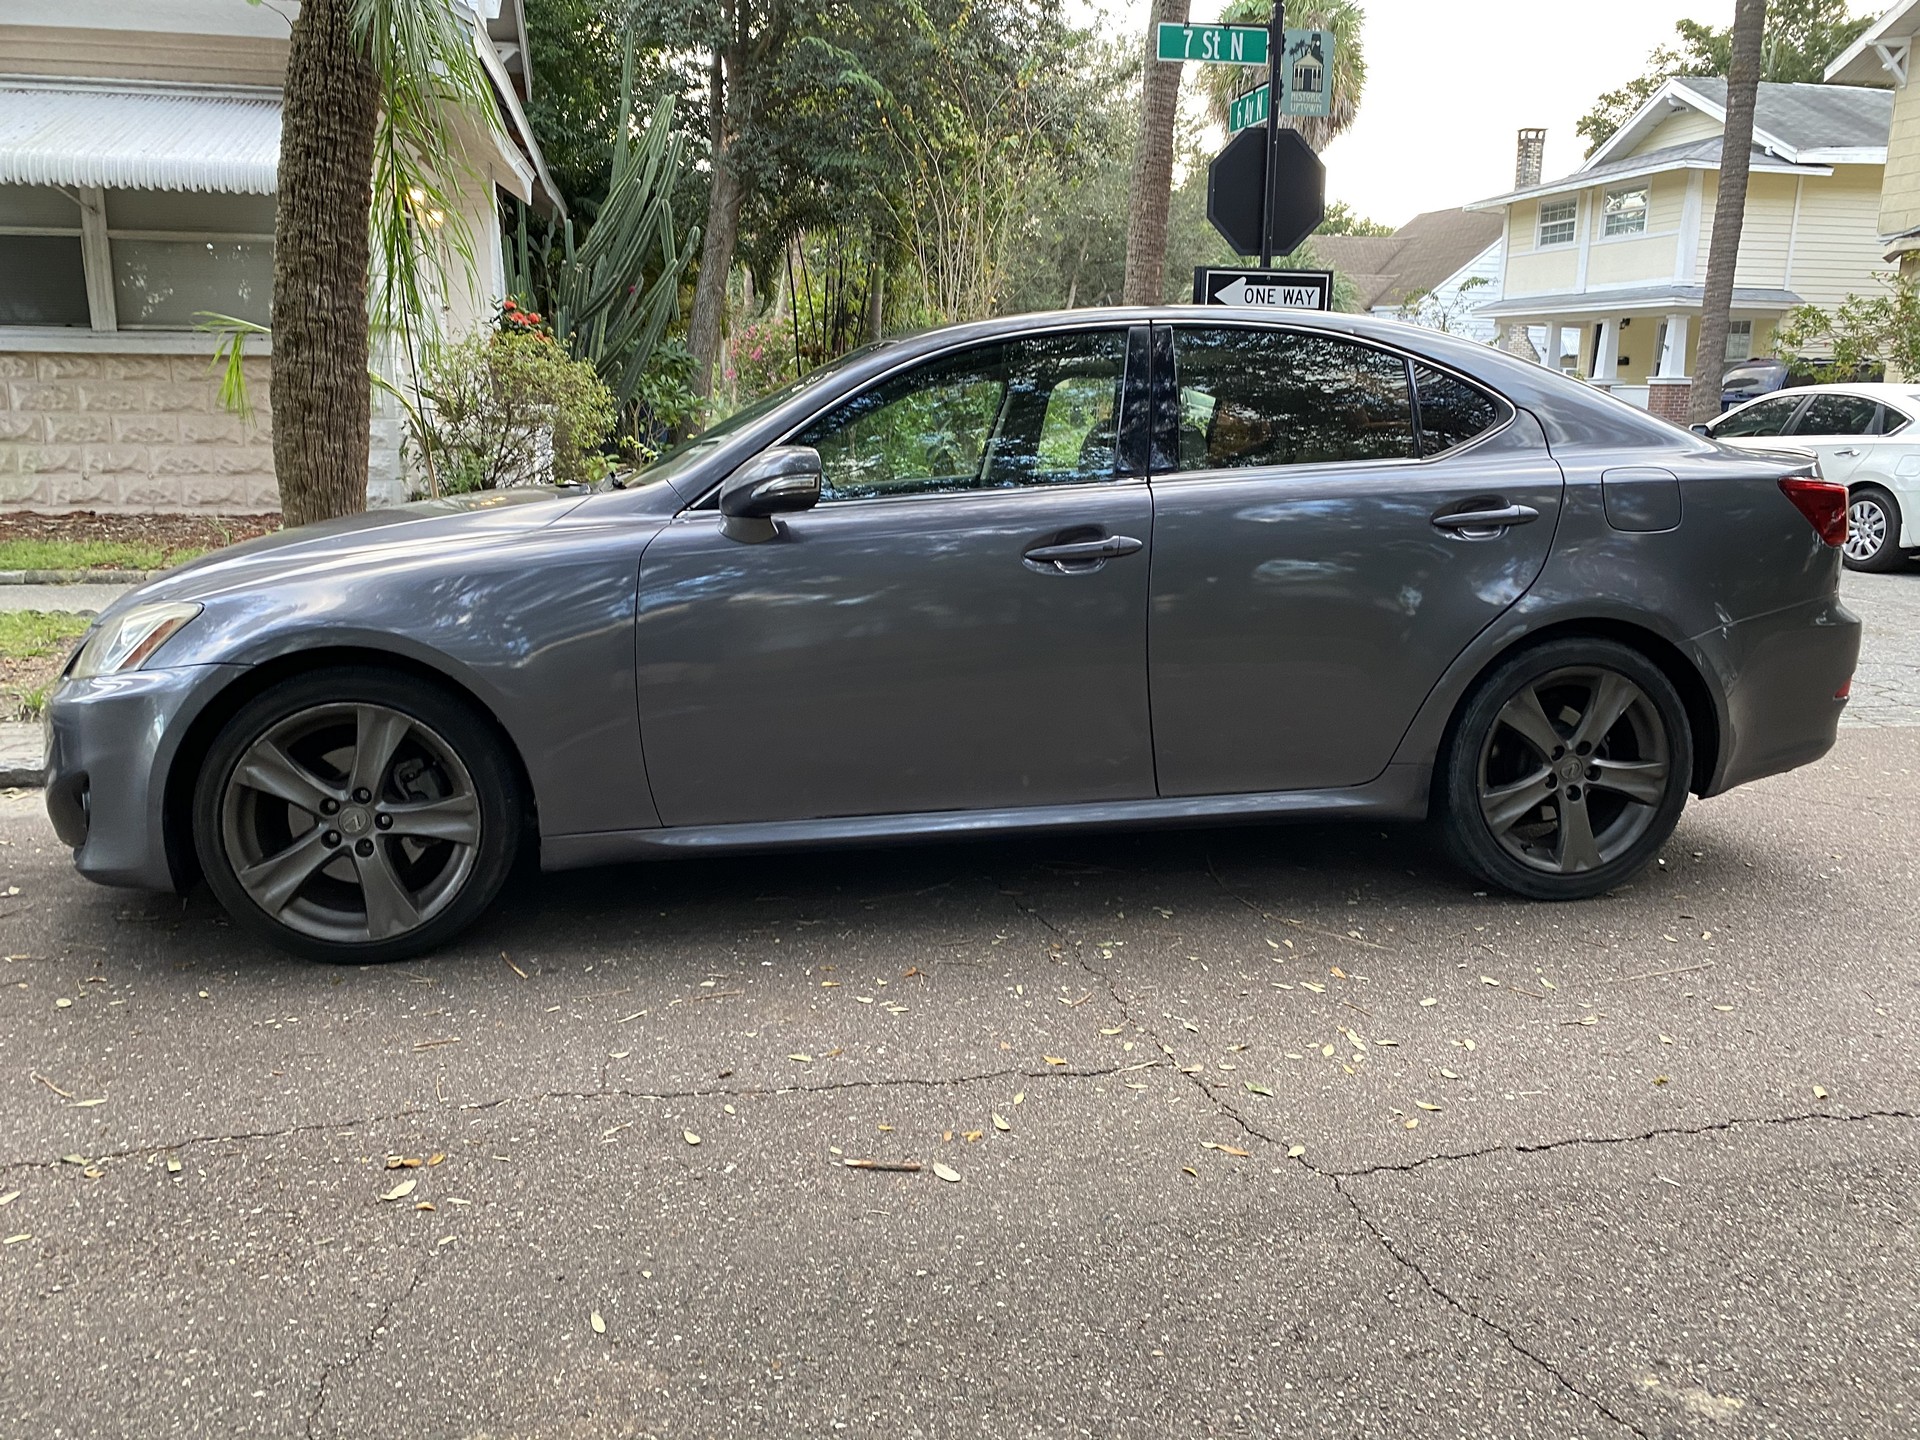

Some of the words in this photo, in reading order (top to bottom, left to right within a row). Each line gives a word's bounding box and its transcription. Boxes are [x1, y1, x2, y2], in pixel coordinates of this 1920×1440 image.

[1183, 29, 1194, 58] 7
[1202, 30, 1220, 60] St
[1230, 31, 1244, 61] N
[1290, 91, 1323, 103] HISTORIC
[1236, 101, 1242, 129] 6
[1243, 98, 1254, 126] Av
[1256, 91, 1264, 121] N
[1290, 102, 1322, 113] UPTOWN
[1244, 287, 1276, 305] ONE
[1283, 288, 1316, 306] WAY
